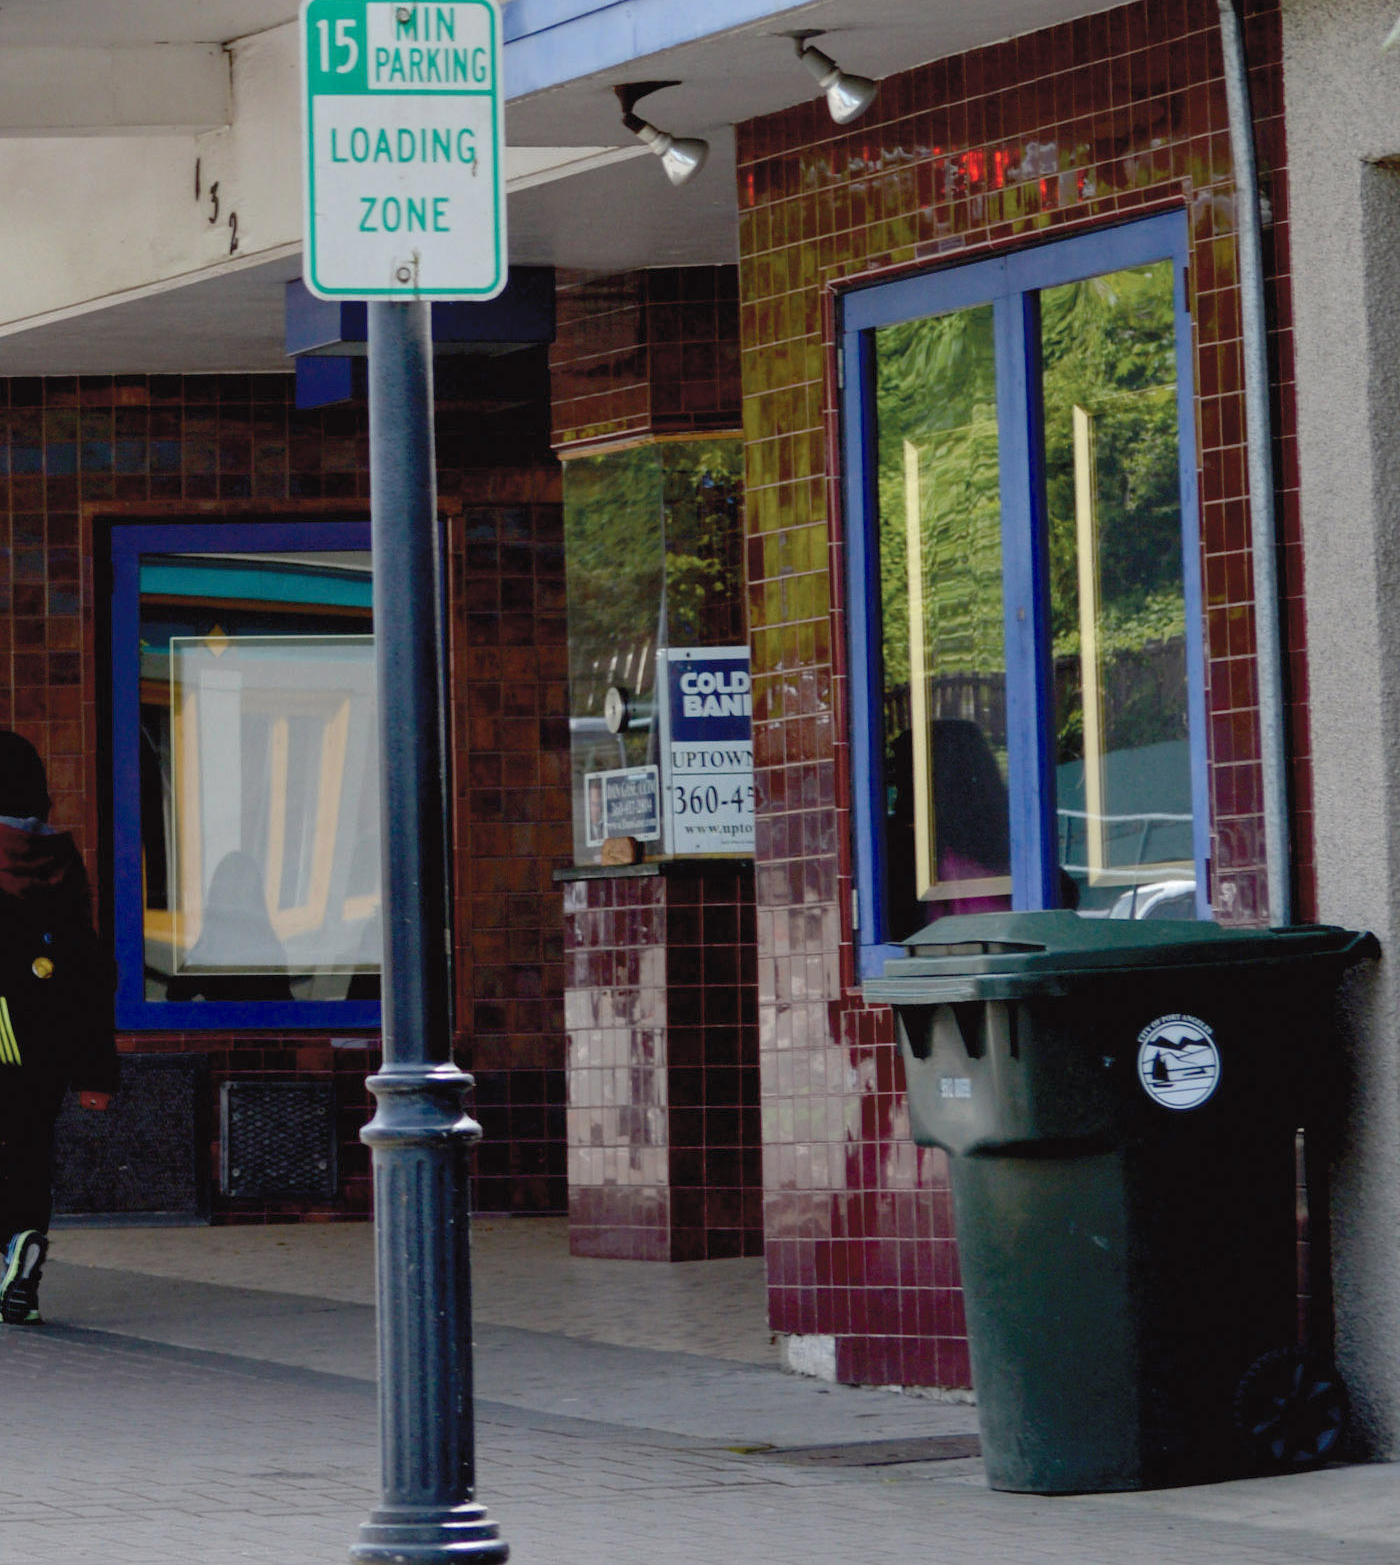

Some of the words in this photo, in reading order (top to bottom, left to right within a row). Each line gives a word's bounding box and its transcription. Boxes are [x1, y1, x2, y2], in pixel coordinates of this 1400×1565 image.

[396, 6, 456, 43] MIN
[316, 18, 360, 74] 15
[375, 47, 487, 84] PARKING
[331, 127, 476, 165] LOADING
[359, 196, 451, 233] ZONE
[1160, 1013, 1181, 1024] PORT
[1182, 1014, 1214, 1035] ANGELES
